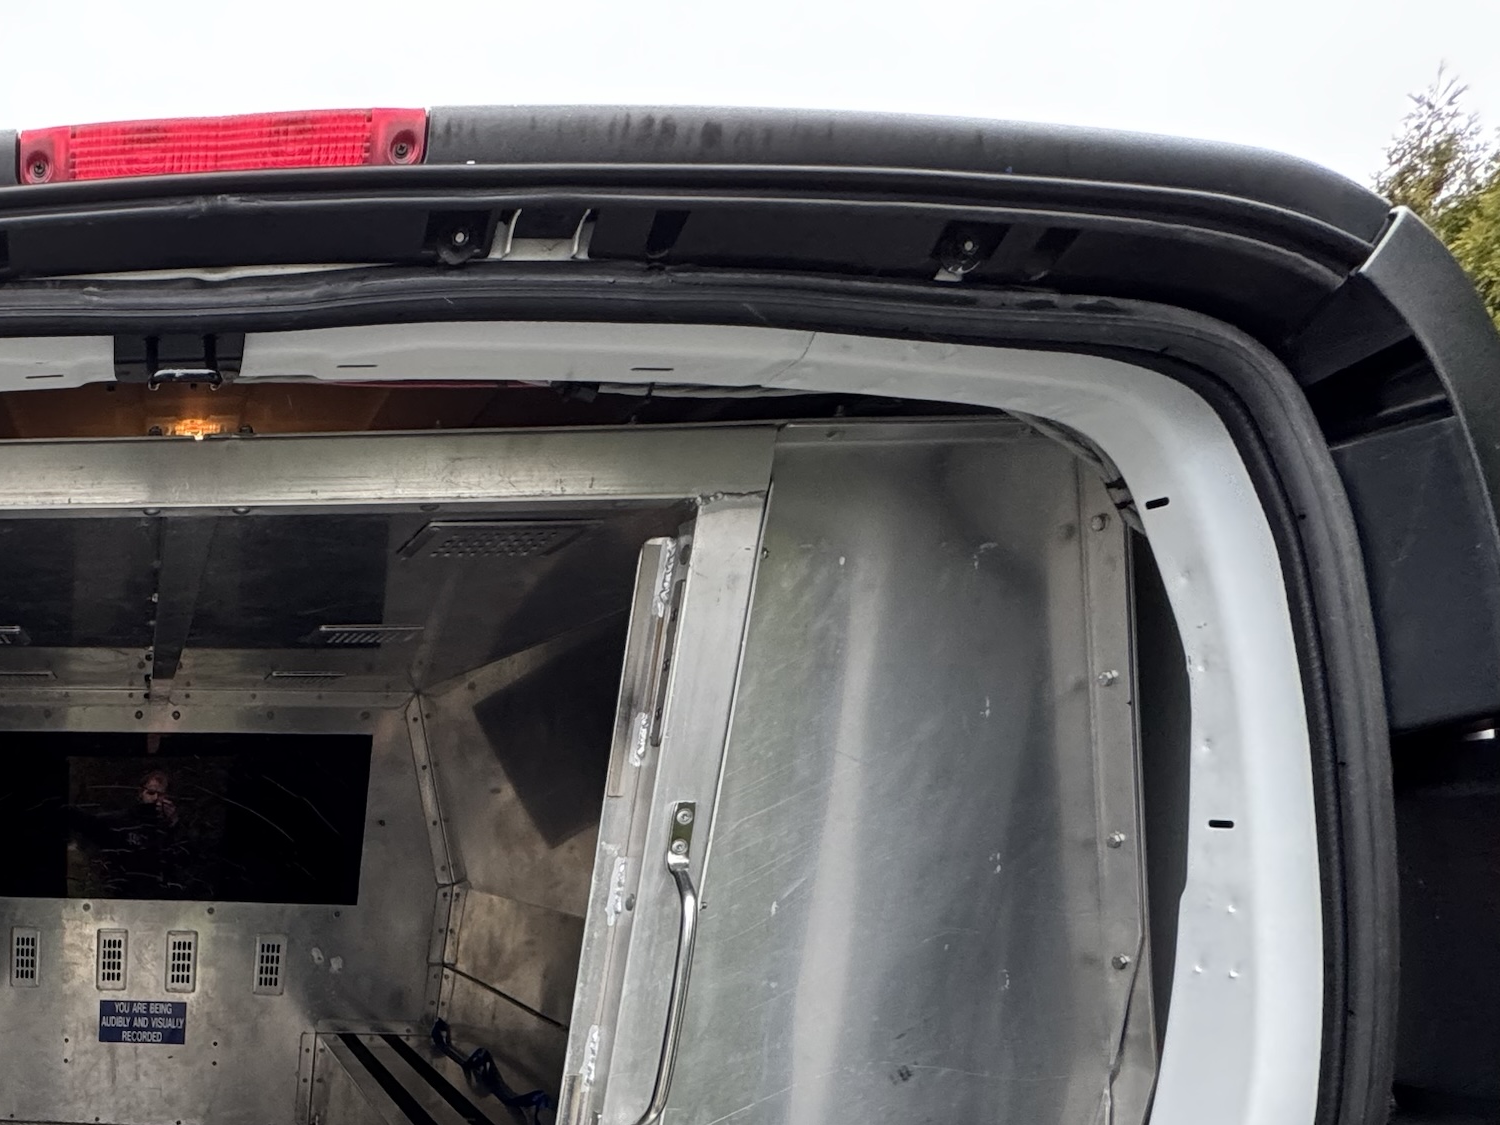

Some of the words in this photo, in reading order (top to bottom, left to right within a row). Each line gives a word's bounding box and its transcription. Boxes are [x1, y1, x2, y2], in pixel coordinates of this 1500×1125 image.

[114, 1002, 130, 1013] YOU
[132, 1002, 147, 1014] ARE
[149, 1003, 172, 1015] BEING
[101, 1016, 131, 1028] AUDIBLY
[133, 1016, 149, 1028] AND
[150, 1017, 185, 1029] VISUALLY
[122, 1031, 162, 1042] RECORDED
